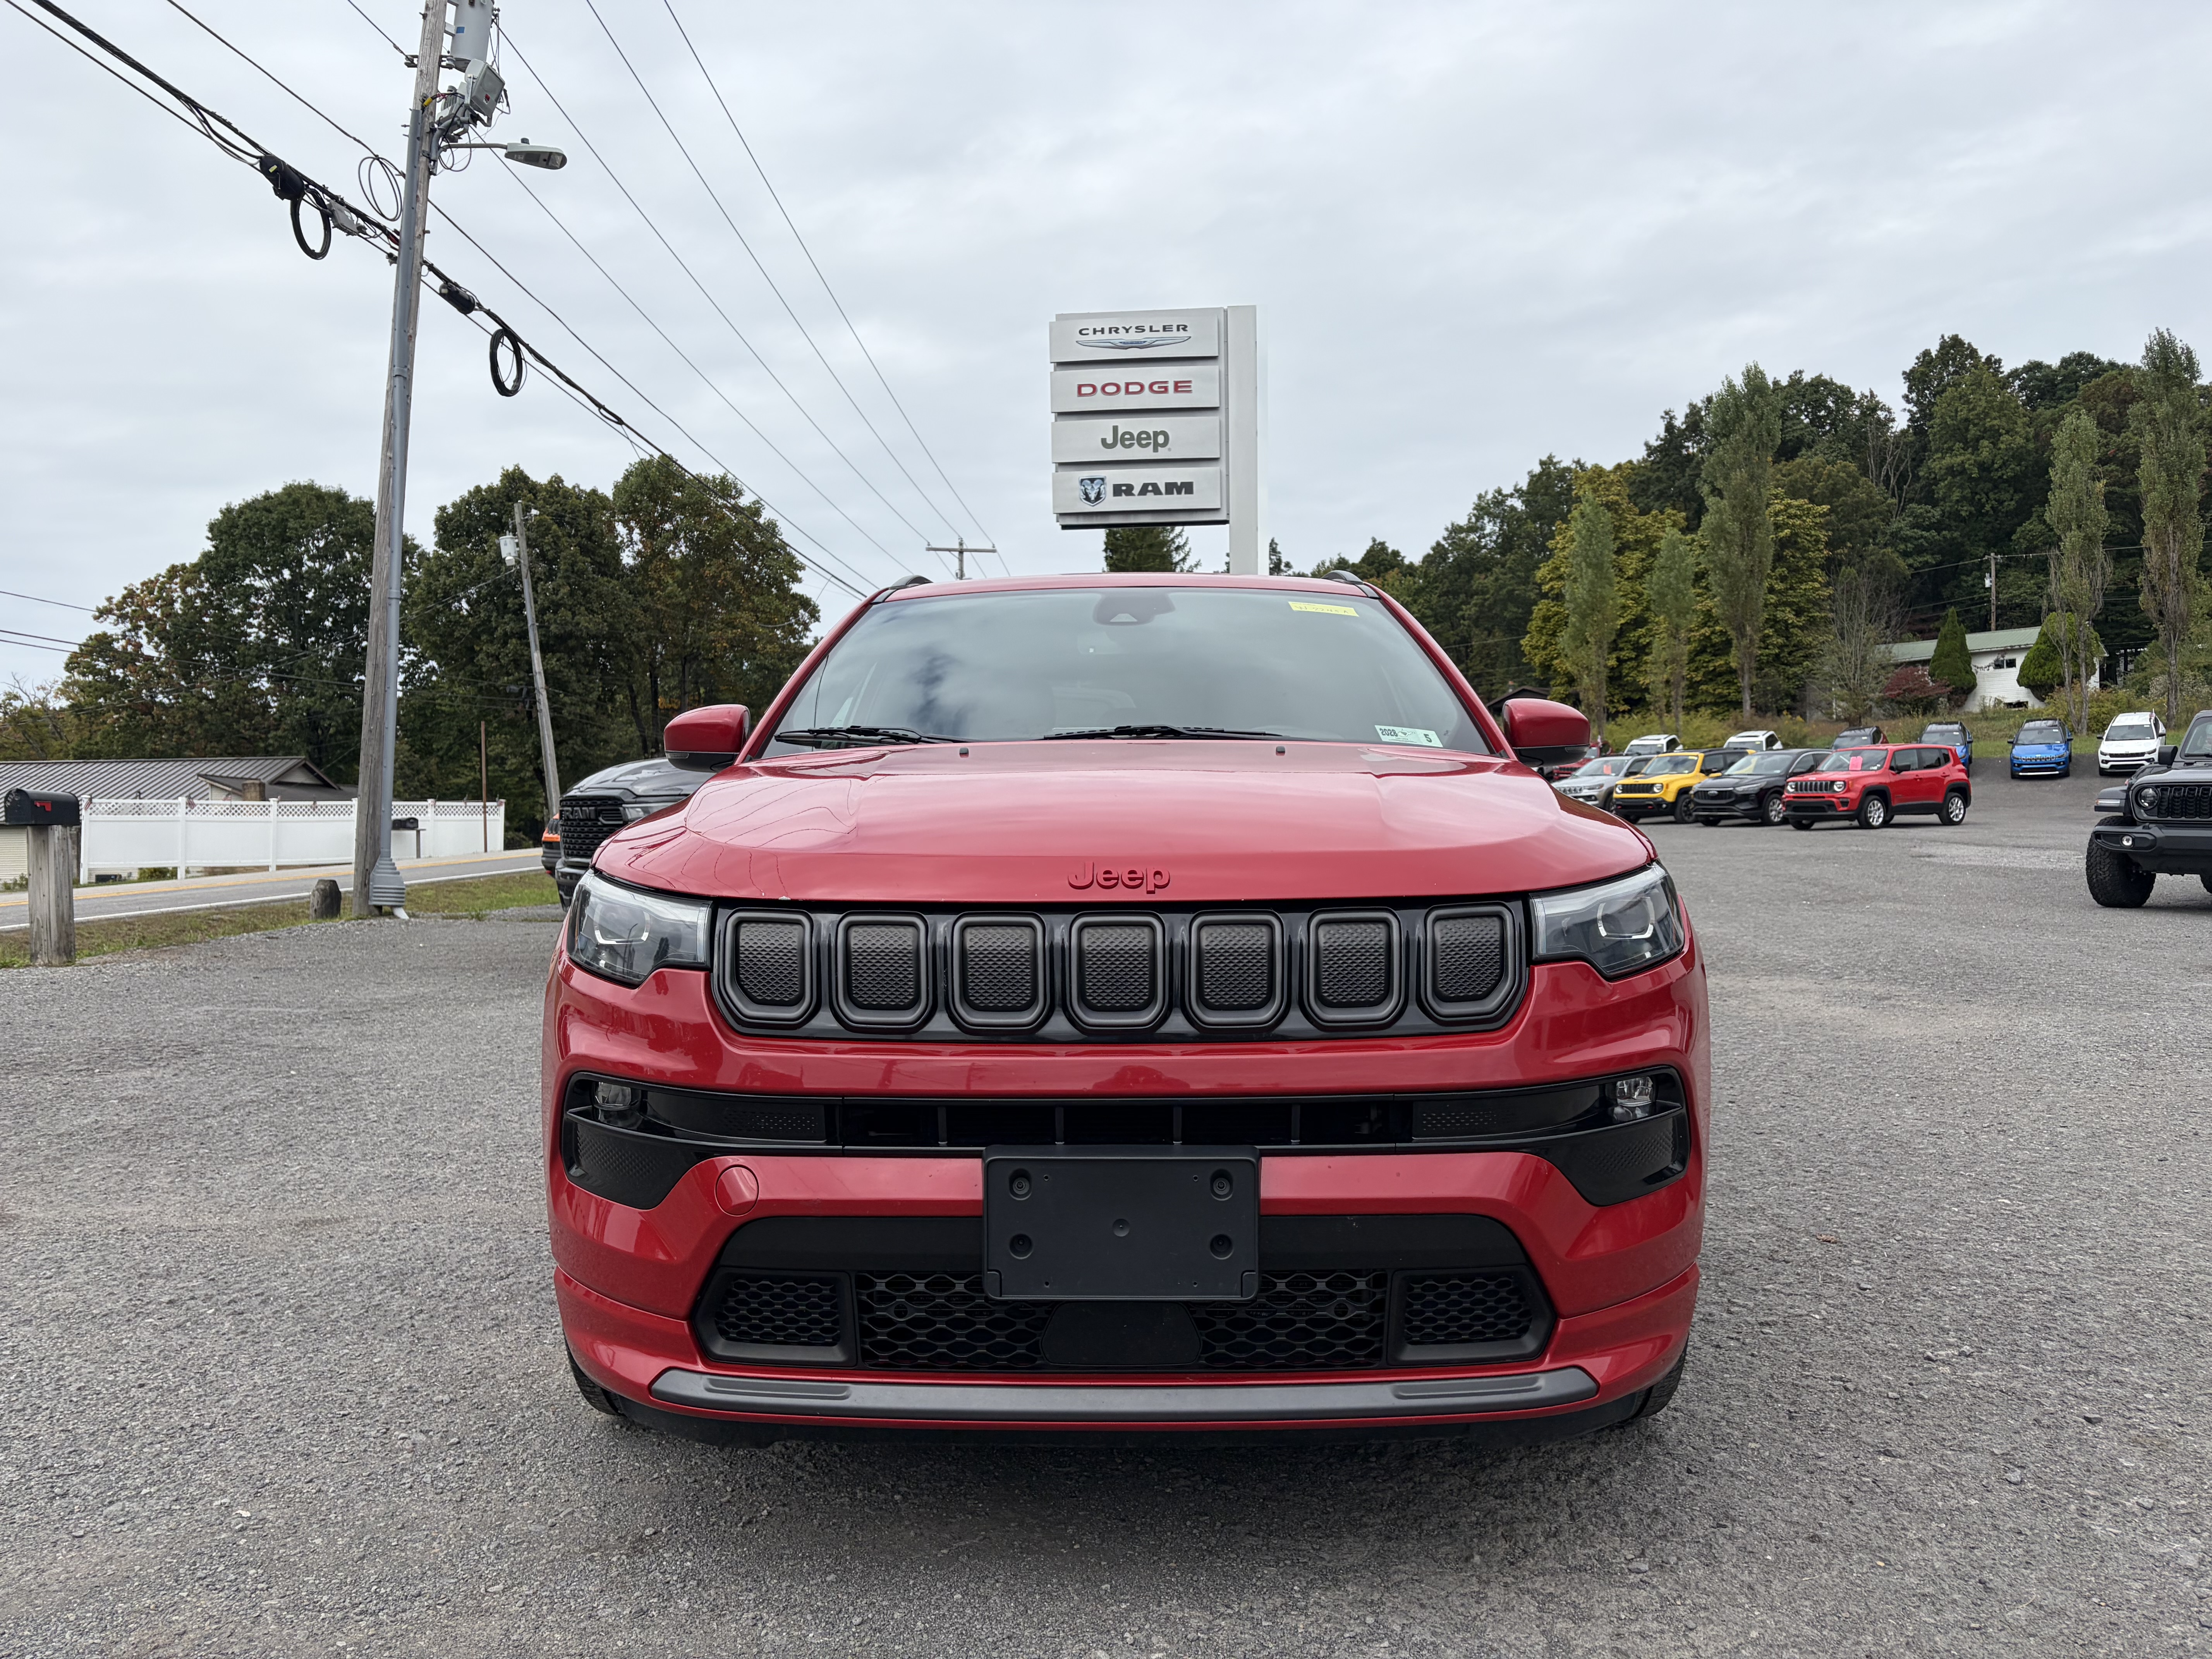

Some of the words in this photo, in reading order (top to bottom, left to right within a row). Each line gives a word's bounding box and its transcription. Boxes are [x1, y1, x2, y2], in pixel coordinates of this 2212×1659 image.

[1078, 324, 1188, 336] CHRYSLER
[1077, 380, 1193, 397] DODGE
[1101, 425, 1170, 453] Jeep
[1112, 481, 1194, 497] RAM
[1423, 733, 1432, 743] 5
[563, 807, 596, 819] RAM
[1068, 861, 1170, 894] Jeep
